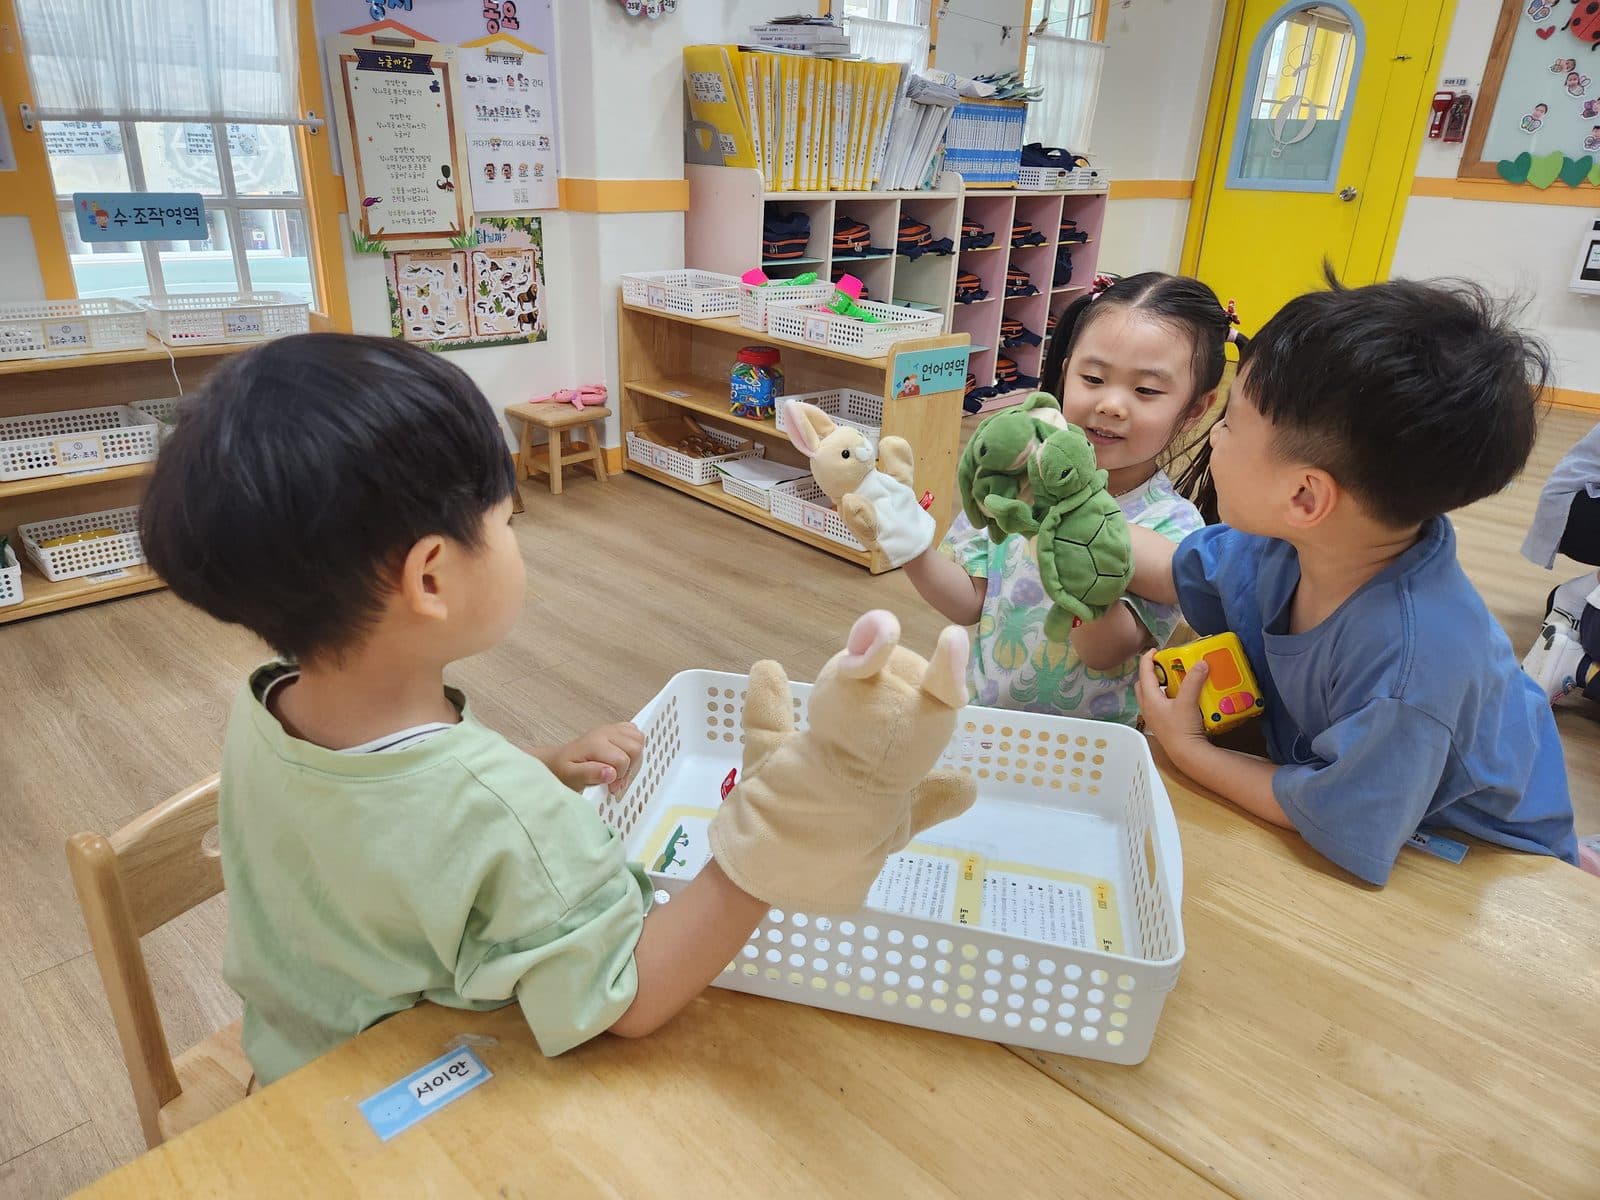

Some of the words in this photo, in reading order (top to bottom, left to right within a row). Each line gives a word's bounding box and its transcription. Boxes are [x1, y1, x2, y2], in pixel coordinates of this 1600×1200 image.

[483, 0, 520, 34] 동요
[531, 79, 544, 88] 간다
[516, 139, 537, 148] 서로서로
[921, 359, 966, 382] 언어영역
[416, 1060, 470, 1098] 서이안
